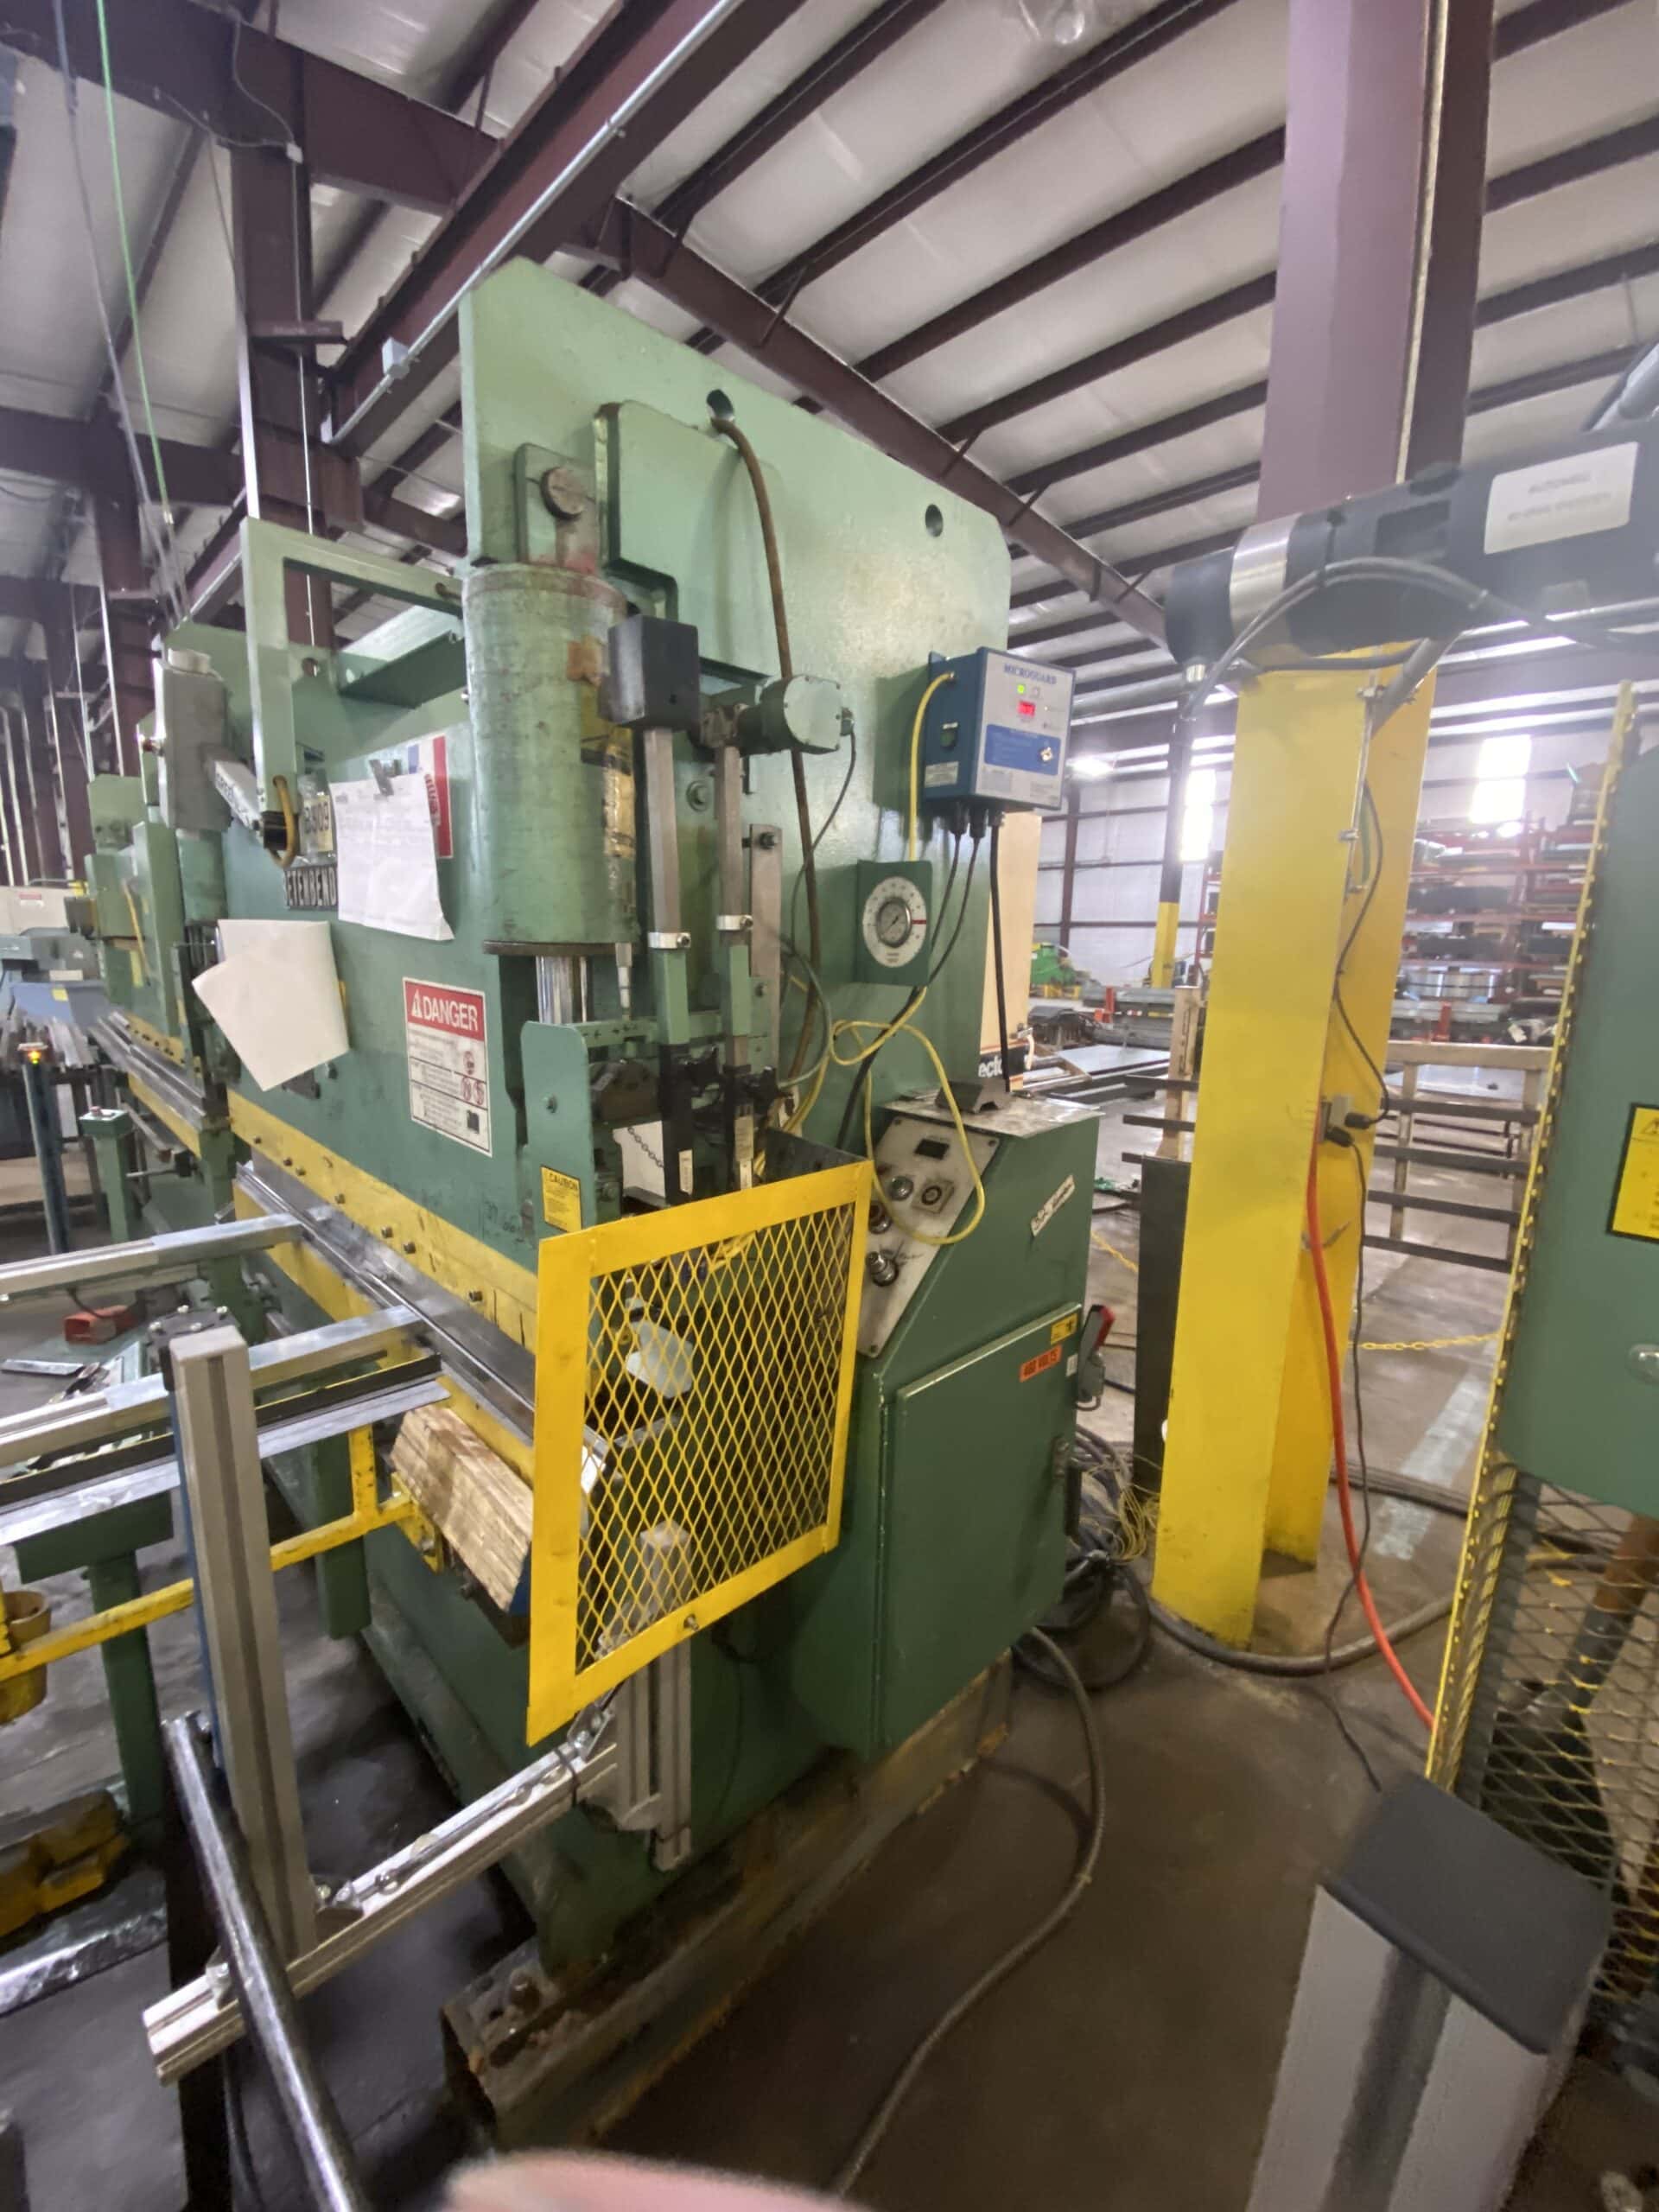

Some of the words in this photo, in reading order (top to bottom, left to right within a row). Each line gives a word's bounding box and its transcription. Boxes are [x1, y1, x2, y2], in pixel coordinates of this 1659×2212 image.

[1004, 664, 1057, 684] MICROGUARD
[423, 995, 478, 1032] DANGER
[550, 1173, 578, 1190] CAUTION
